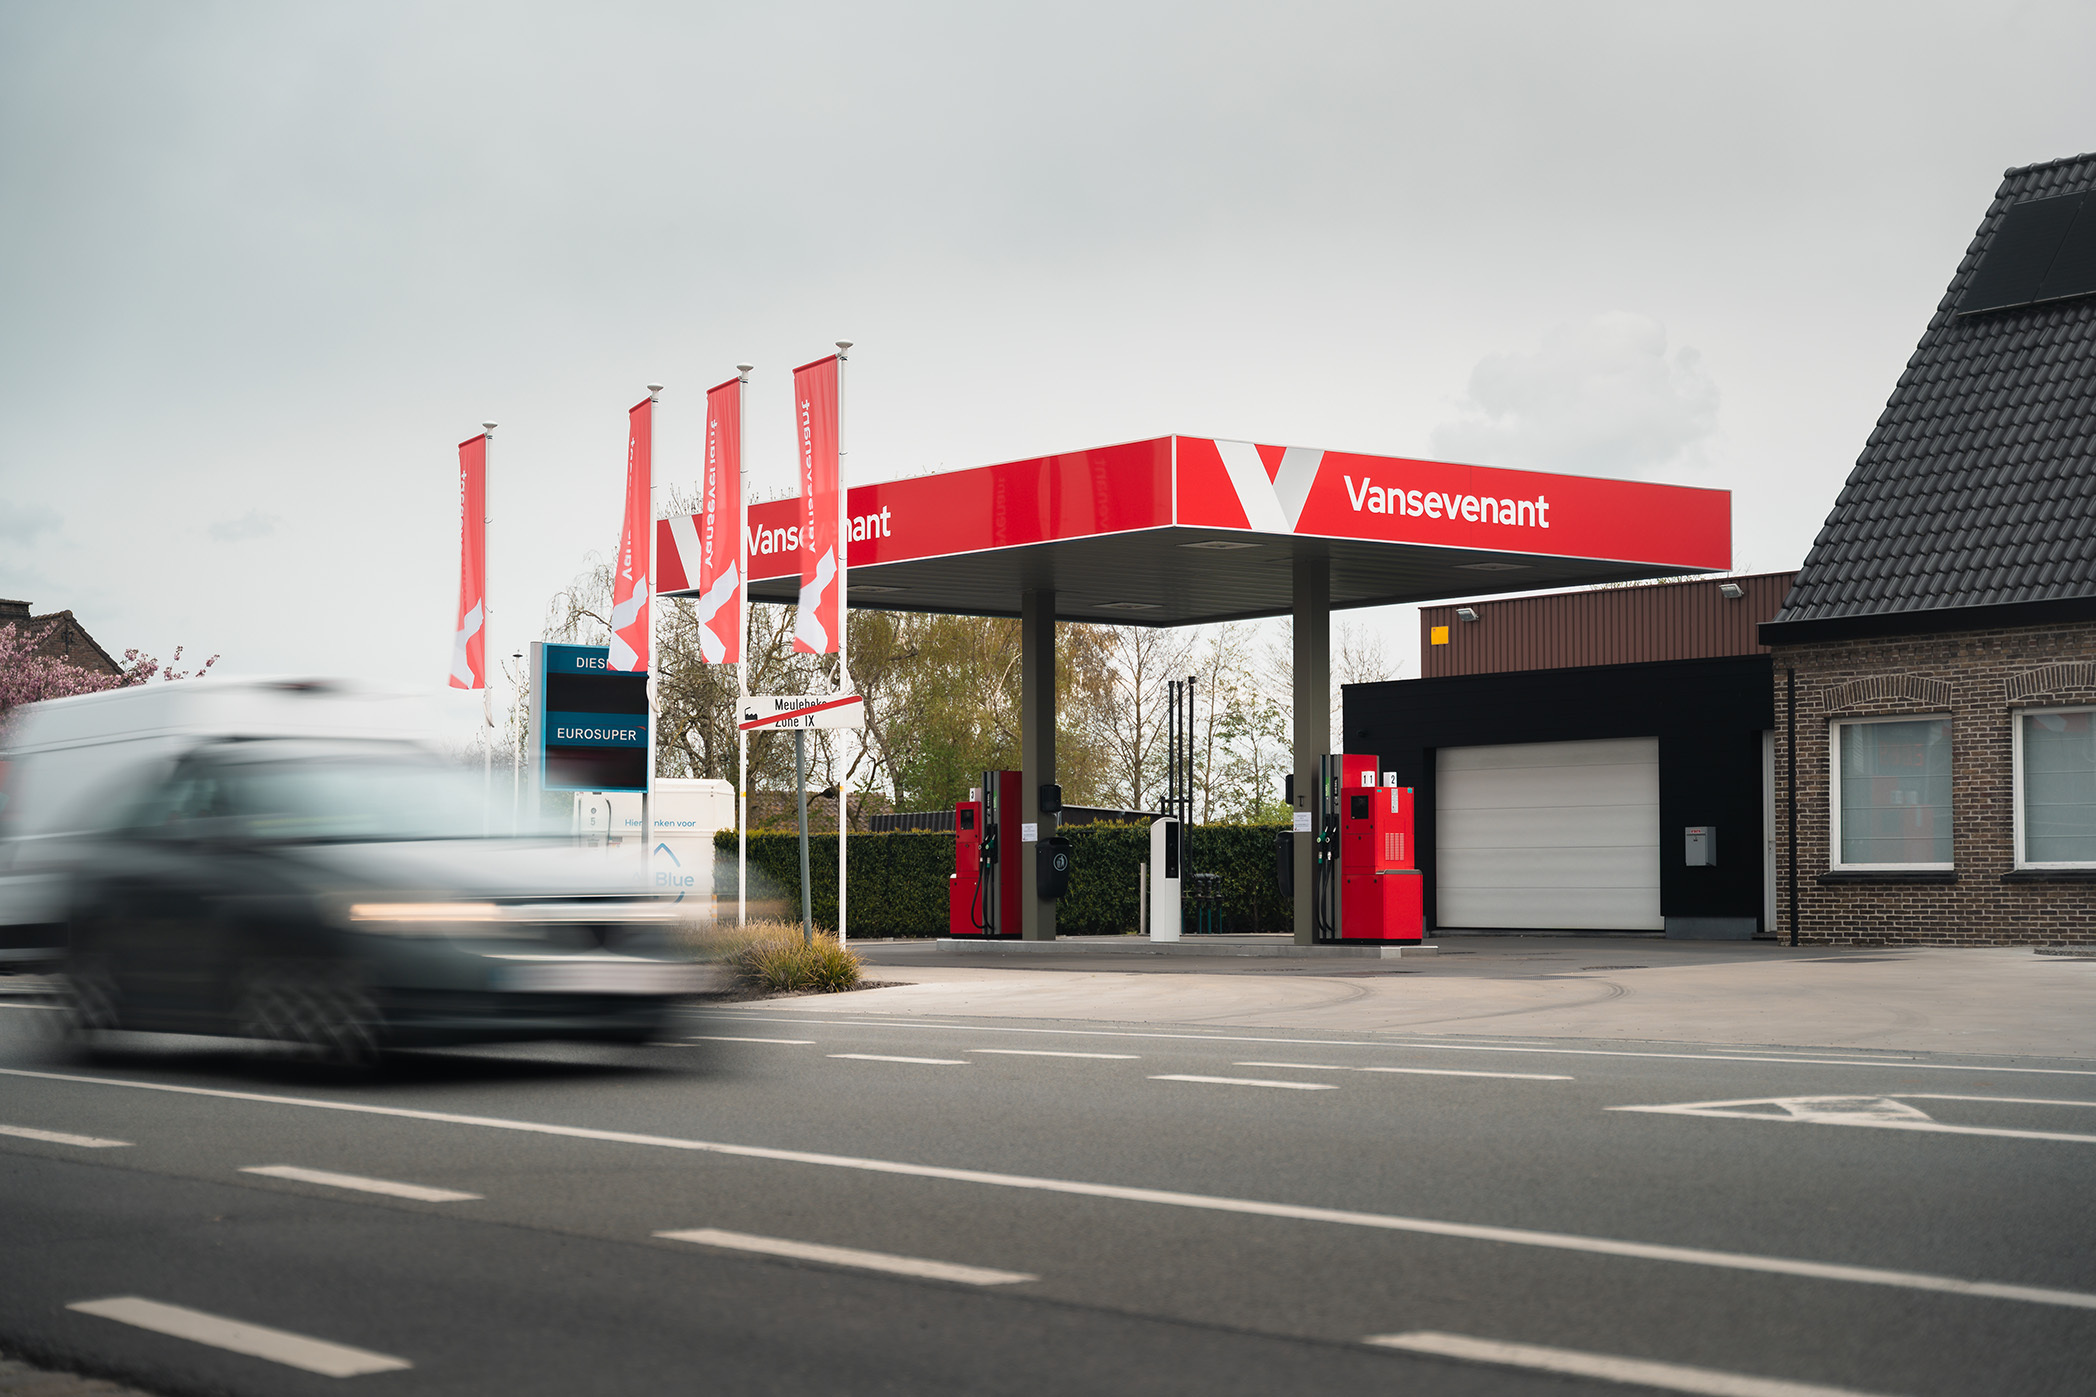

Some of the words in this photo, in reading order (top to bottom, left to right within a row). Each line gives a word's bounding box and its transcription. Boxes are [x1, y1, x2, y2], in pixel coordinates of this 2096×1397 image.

[1343, 474, 1550, 529] Vansevenant
[804, 714, 815, 727] IX
[557, 727, 637, 741] EUROSUPER
[1390, 774, 1395, 784] 2
